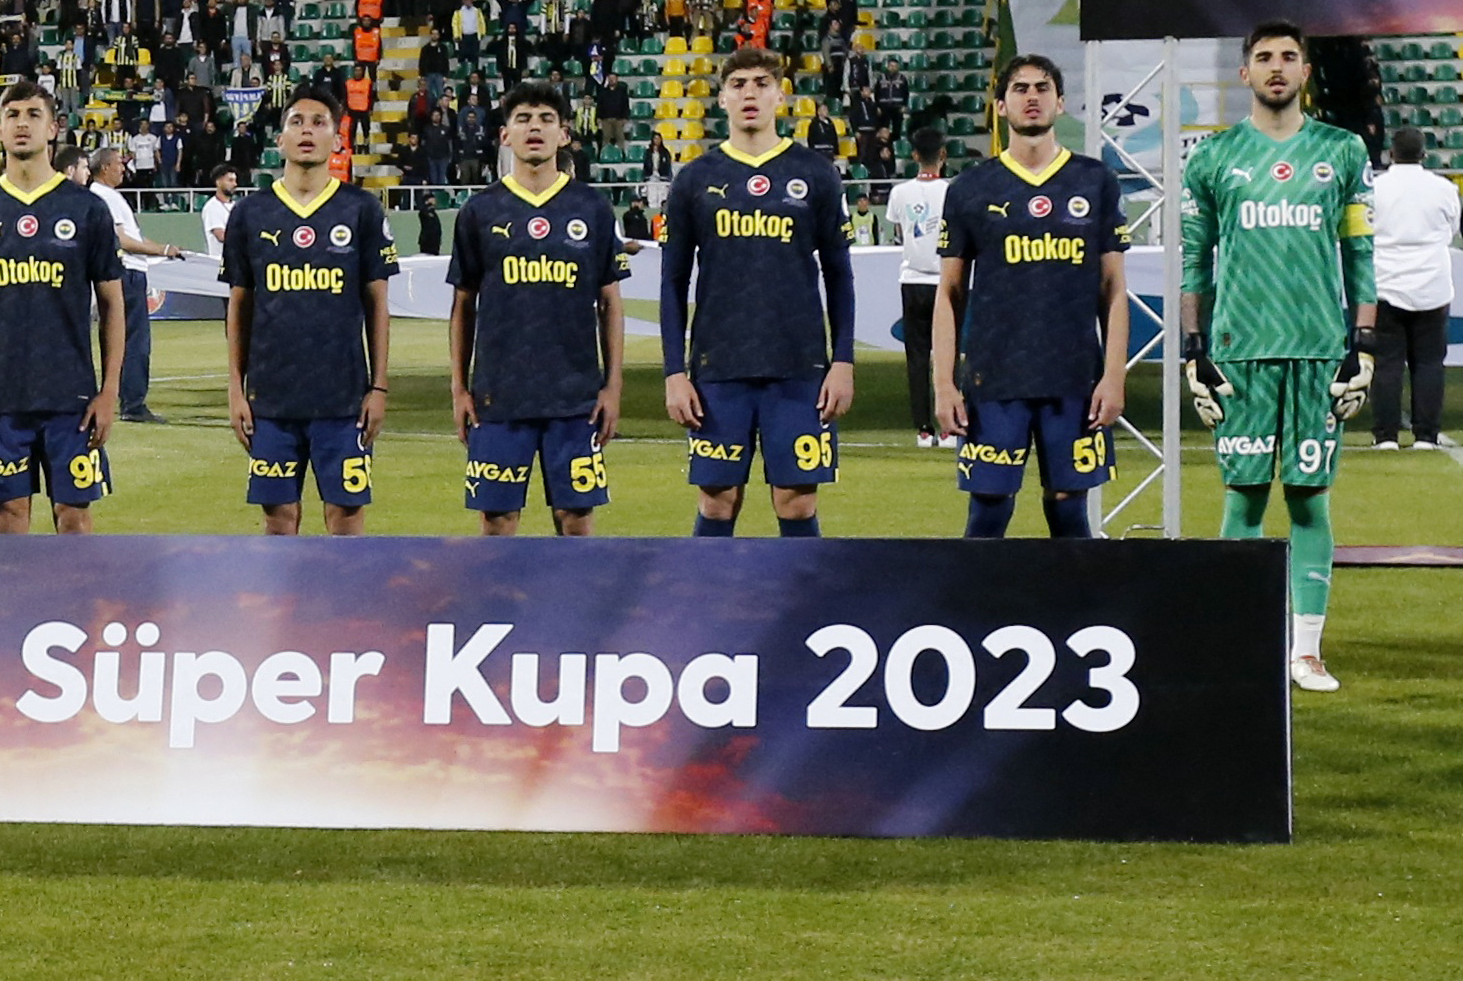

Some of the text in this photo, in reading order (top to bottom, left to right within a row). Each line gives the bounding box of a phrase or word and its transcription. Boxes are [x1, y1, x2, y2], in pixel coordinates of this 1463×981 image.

[715, 209, 794, 243] Otokoç
[1241, 199, 1323, 230] Otokoç
[1004, 233, 1085, 265] Otokoç
[266, 263, 344, 294] Otokoç
[503, 256, 578, 288] Otokoç
[689, 437, 744, 462] YGAZ
[794, 432, 833, 471] 95
[959, 442, 1026, 465] AYGAZ
[69, 448, 103, 489] 92
[466, 461, 529, 483] AYGAZ
[570, 452, 607, 493] 55
[15, 620, 385, 750] Süper
[423, 623, 759, 754] Kupa
[804, 624, 1140, 733] 2023
